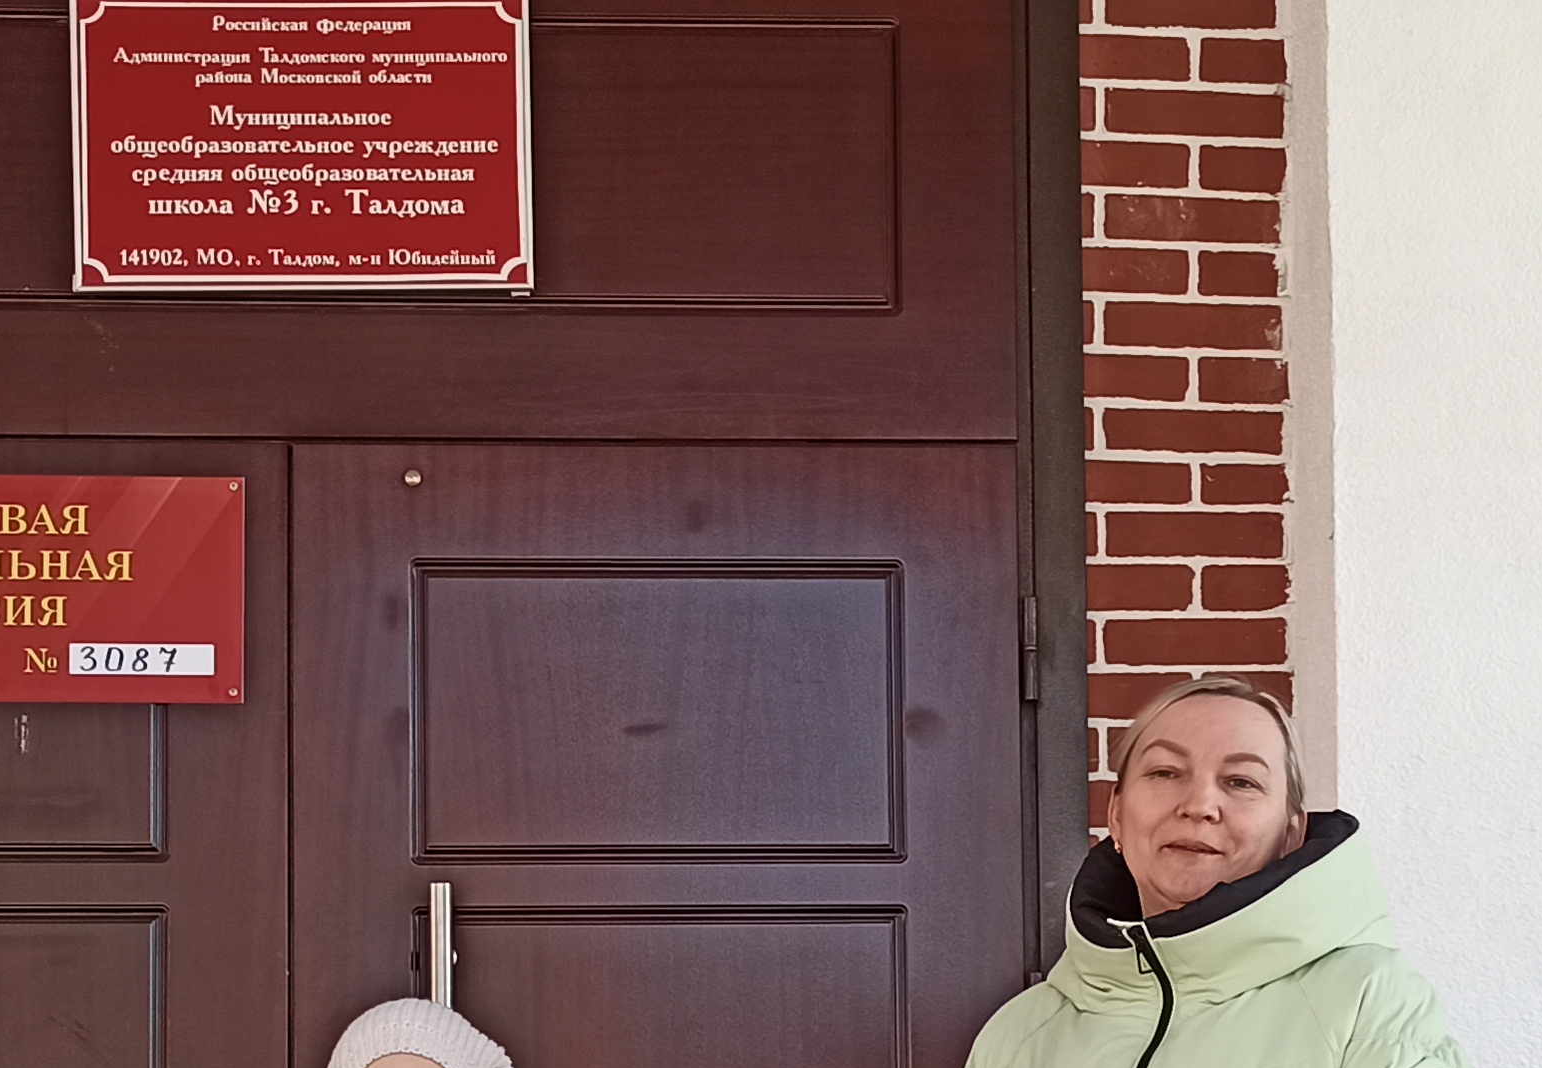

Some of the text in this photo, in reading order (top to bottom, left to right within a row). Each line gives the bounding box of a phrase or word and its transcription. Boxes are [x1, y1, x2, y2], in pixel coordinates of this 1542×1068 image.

[212, 15, 309, 31] Российская
[113, 46, 508, 67] Администрация Талдомского муниципального
[195, 67, 432, 87] района Московской области
[210, 104, 392, 130] Муниципальное
[110, 136, 499, 158] общеобразовательное учреждение
[131, 163, 475, 187] средняя общеобразовательная
[148, 188, 466, 218] школа №3 г. Талдома
[120, 247, 496, 268] 141902, МО, г. Талдом, м-н Юбилейный
[23, 646, 178, 673] № 3087
